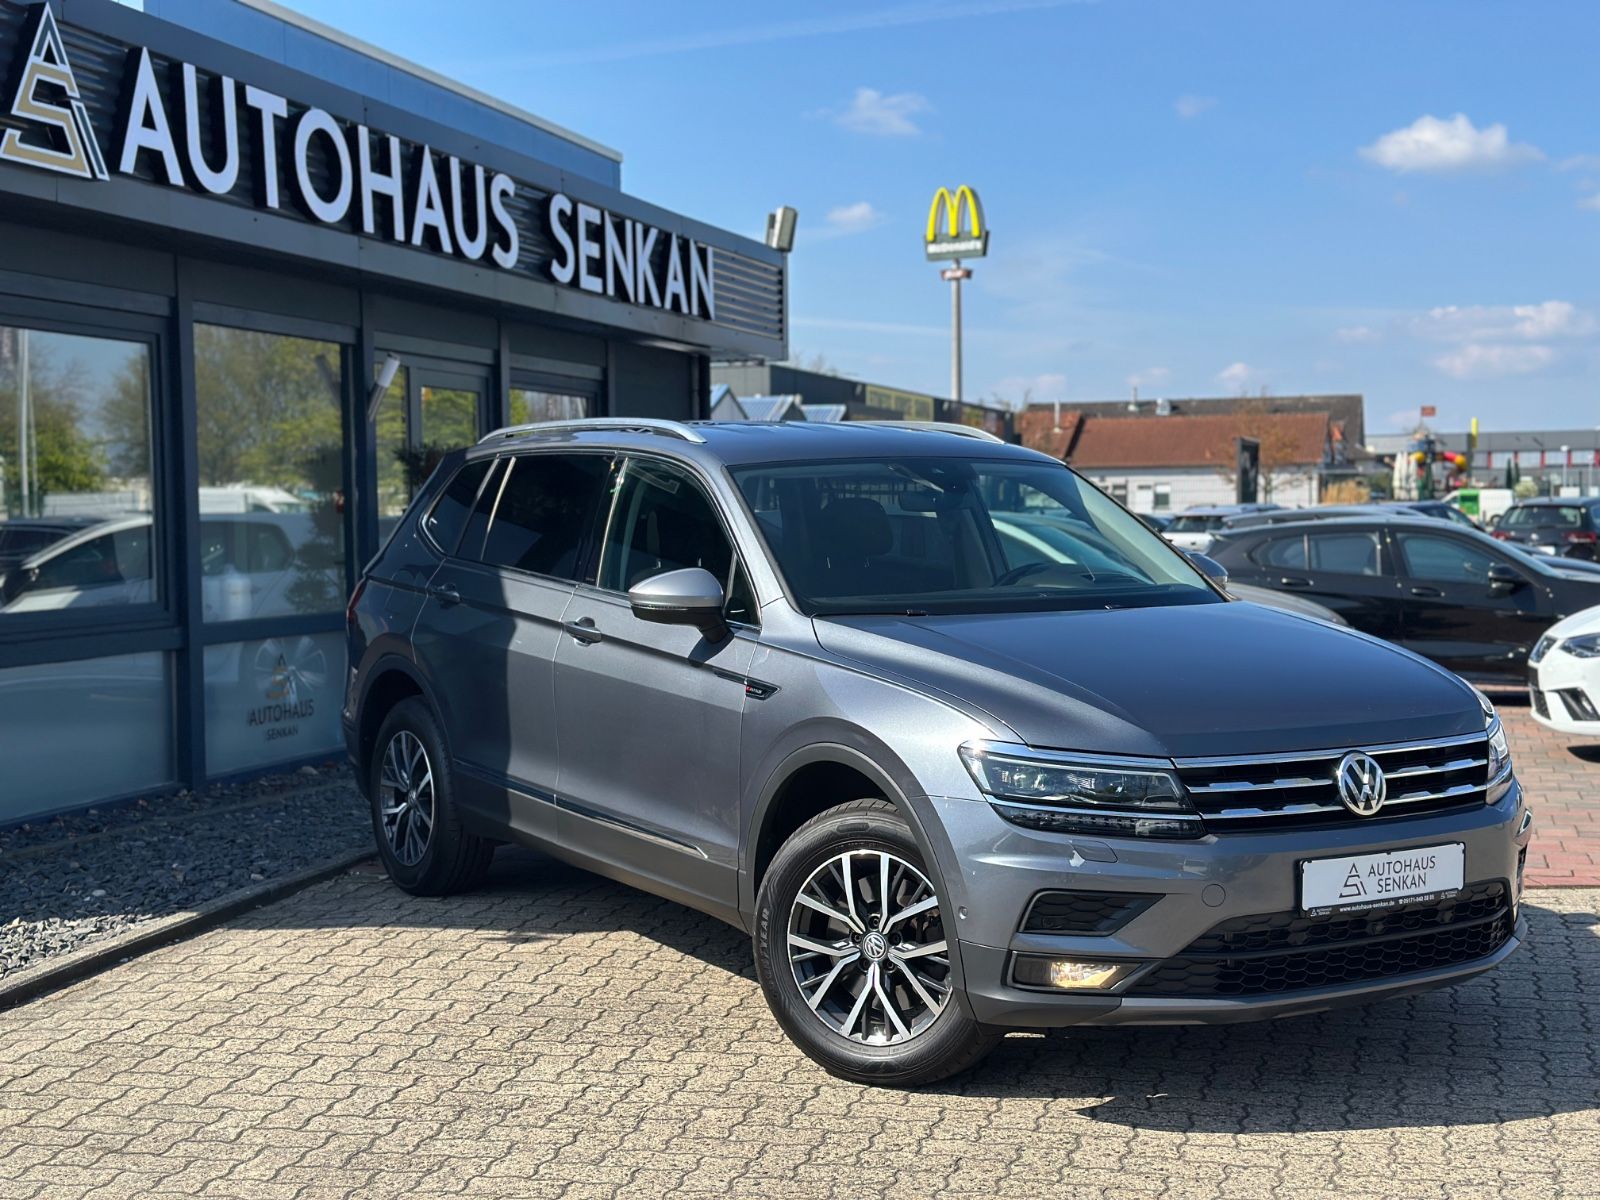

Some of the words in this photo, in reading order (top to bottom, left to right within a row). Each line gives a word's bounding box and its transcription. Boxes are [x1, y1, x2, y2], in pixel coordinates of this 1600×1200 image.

[119, 46, 520, 270] AUTOHAUS
[549, 193, 715, 320] SENKAN
[247, 700, 315, 727] AUTOHAUS
[265, 725, 299, 741] SENKAN
[1368, 855, 1436, 878] AUTOHAUS
[1377, 872, 1427, 894] SENKAN
